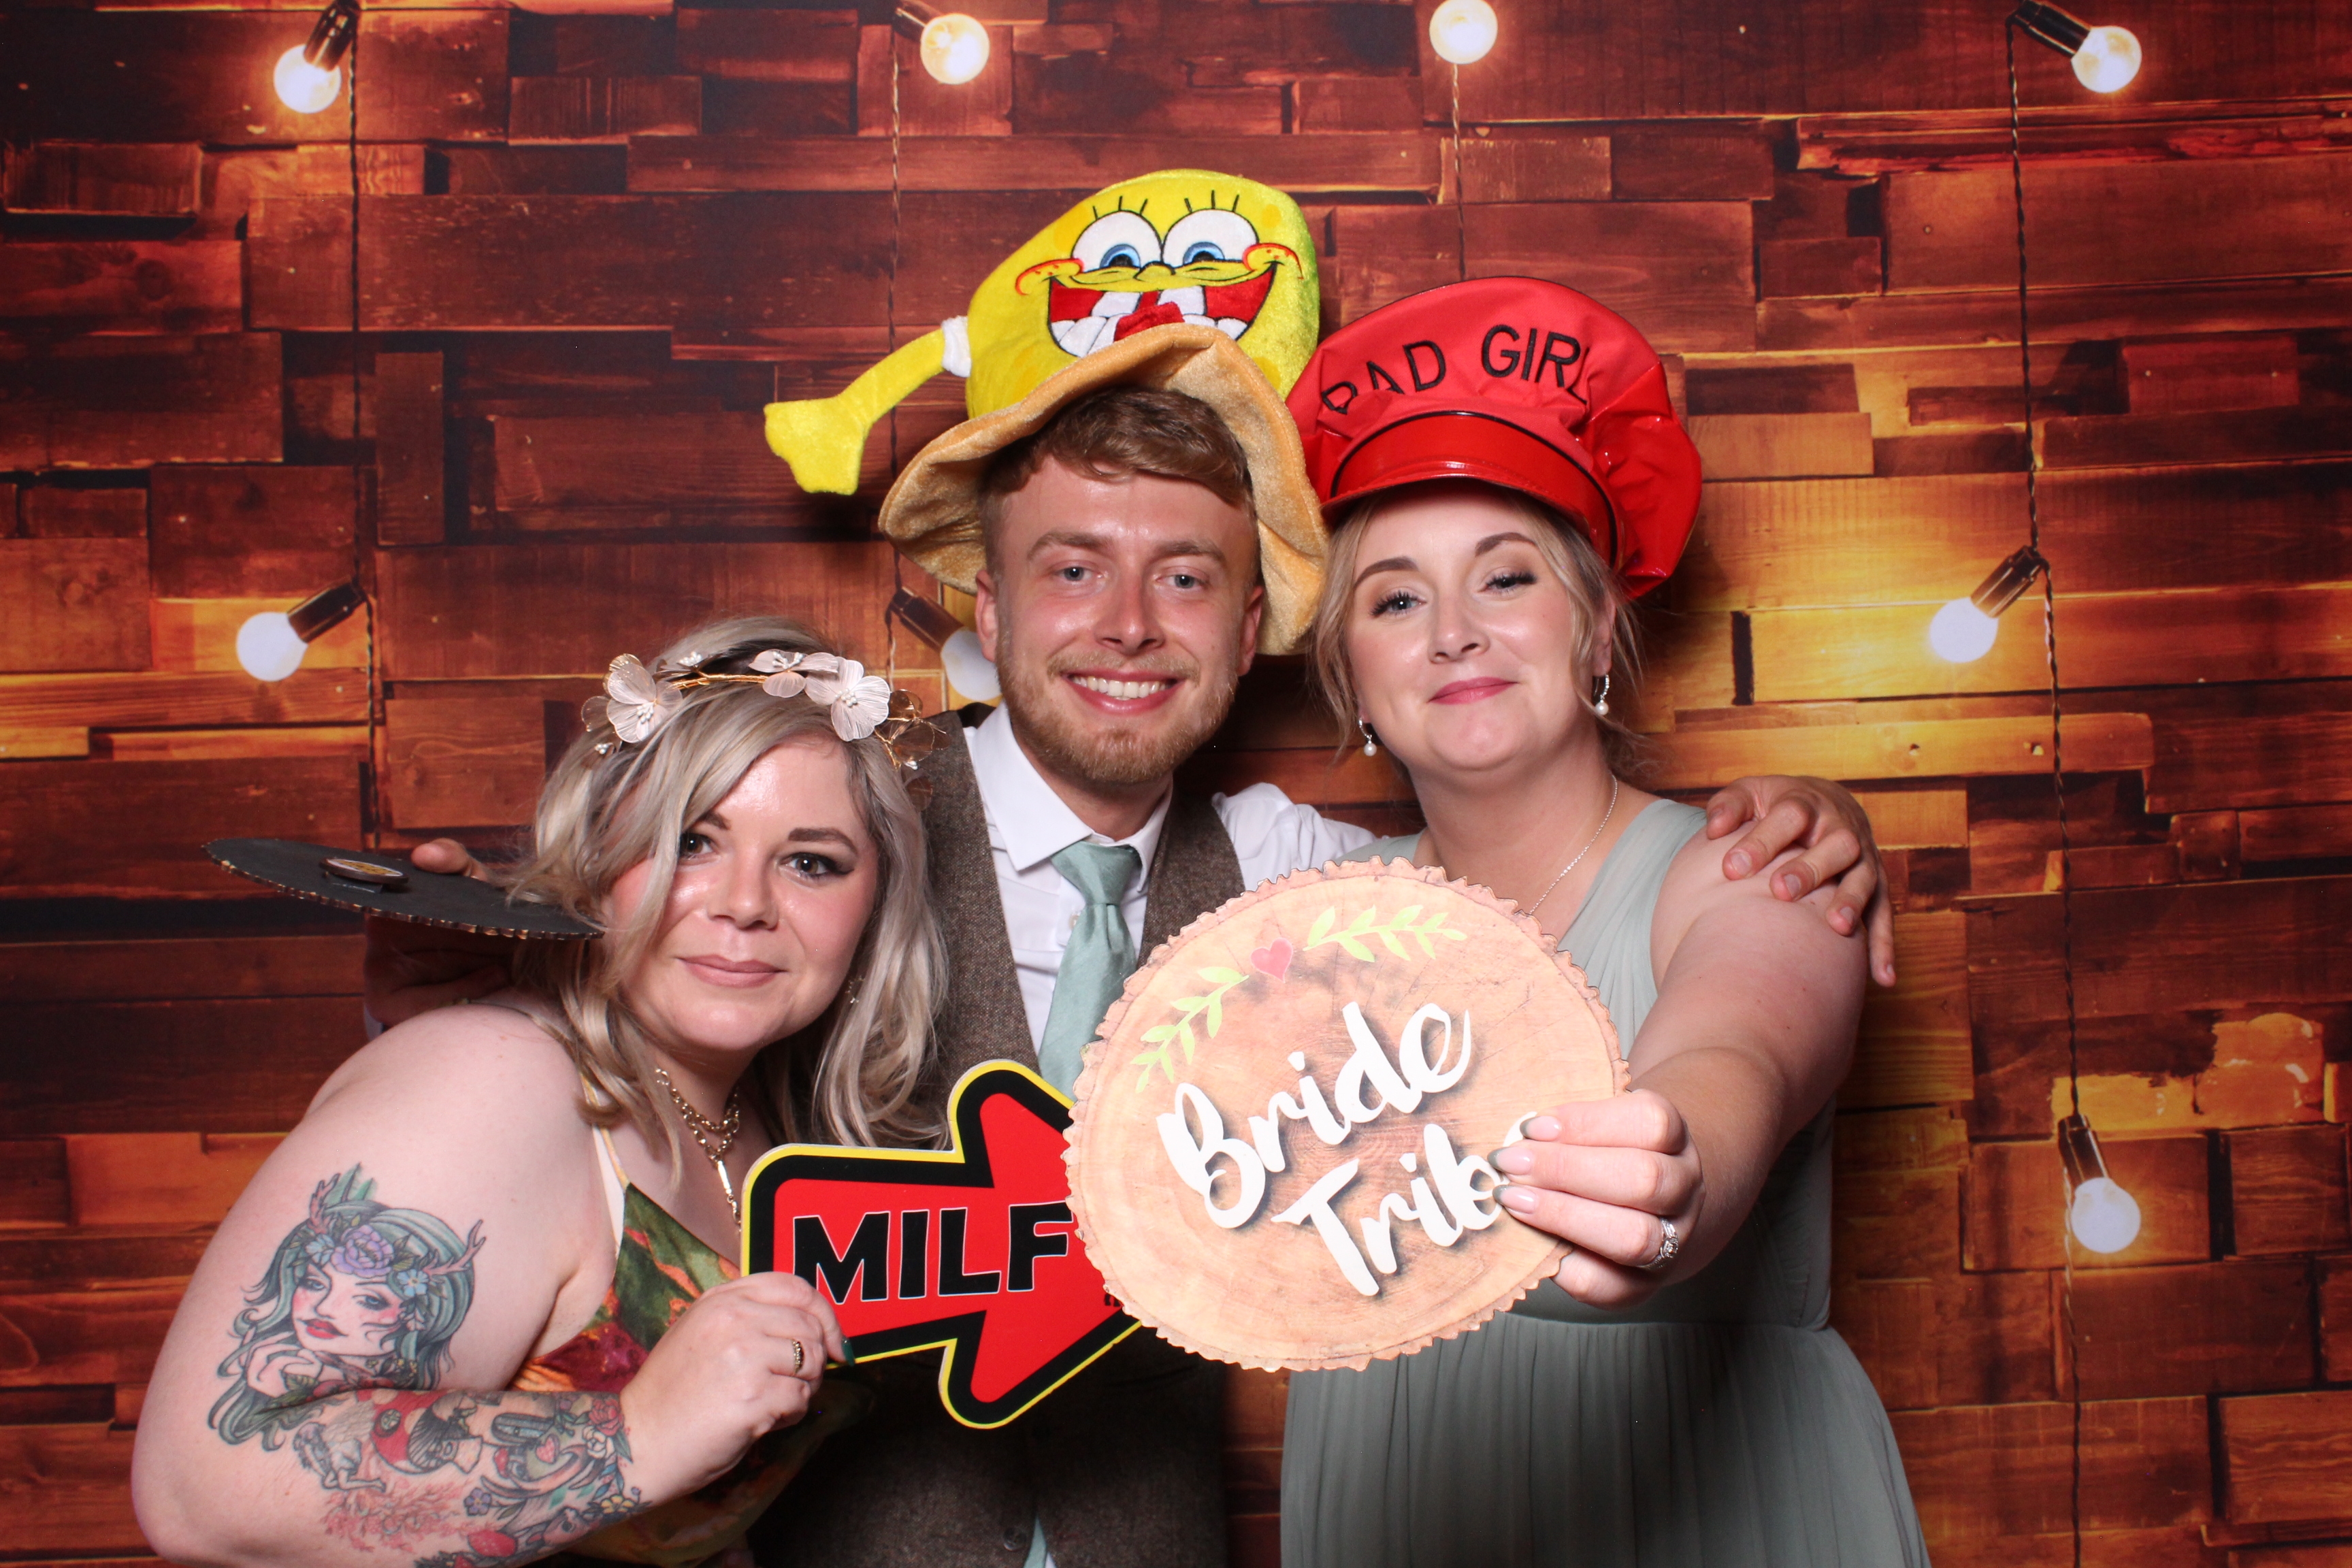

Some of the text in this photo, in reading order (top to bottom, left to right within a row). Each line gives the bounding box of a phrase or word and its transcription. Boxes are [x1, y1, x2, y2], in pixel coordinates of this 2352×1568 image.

[1481, 324, 1590, 405] GIRL
[1156, 1001, 1471, 1229] Bride
[793, 1201, 1074, 1305] MILF
